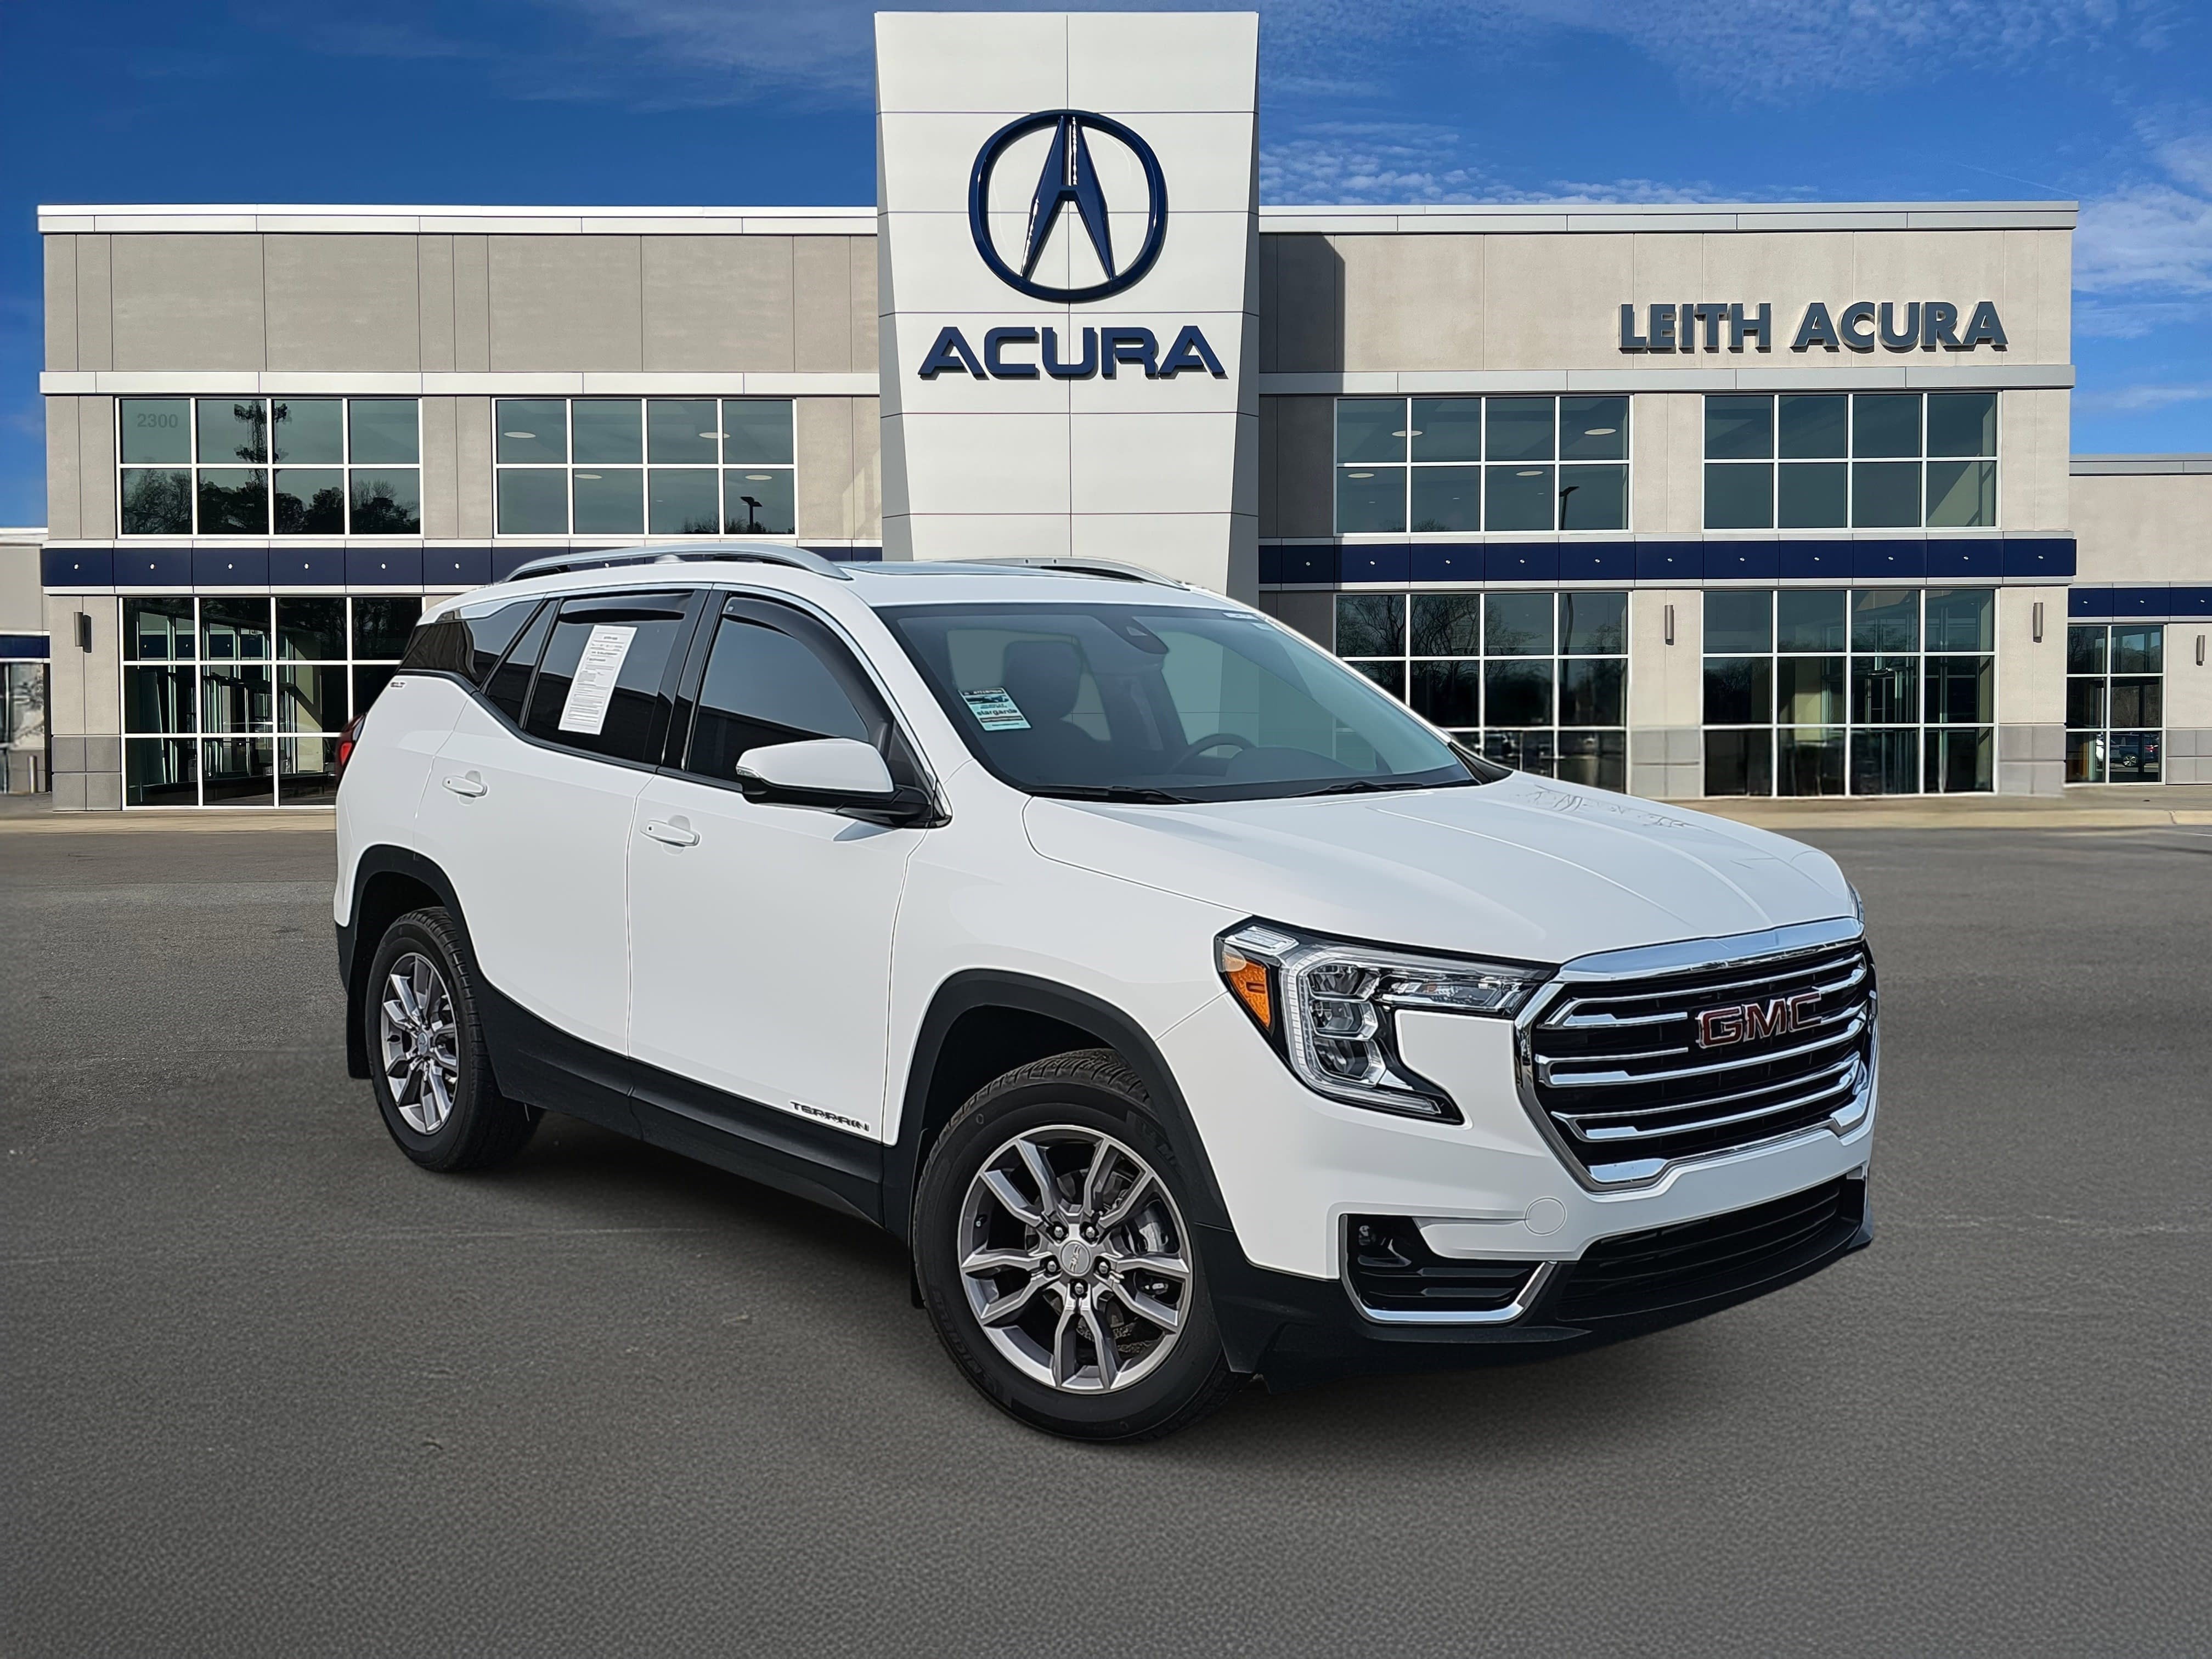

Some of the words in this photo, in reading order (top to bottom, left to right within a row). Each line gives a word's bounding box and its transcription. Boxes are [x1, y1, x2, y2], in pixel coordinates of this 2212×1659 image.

[918, 325, 1227, 380] ACURA
[1618, 302, 1772, 354] LEITH
[1790, 301, 2009, 354] ACURA
[137, 413, 178, 428] 2300
[1695, 991, 1822, 1049] GMC
[789, 1101, 870, 1132] TERRAIN
